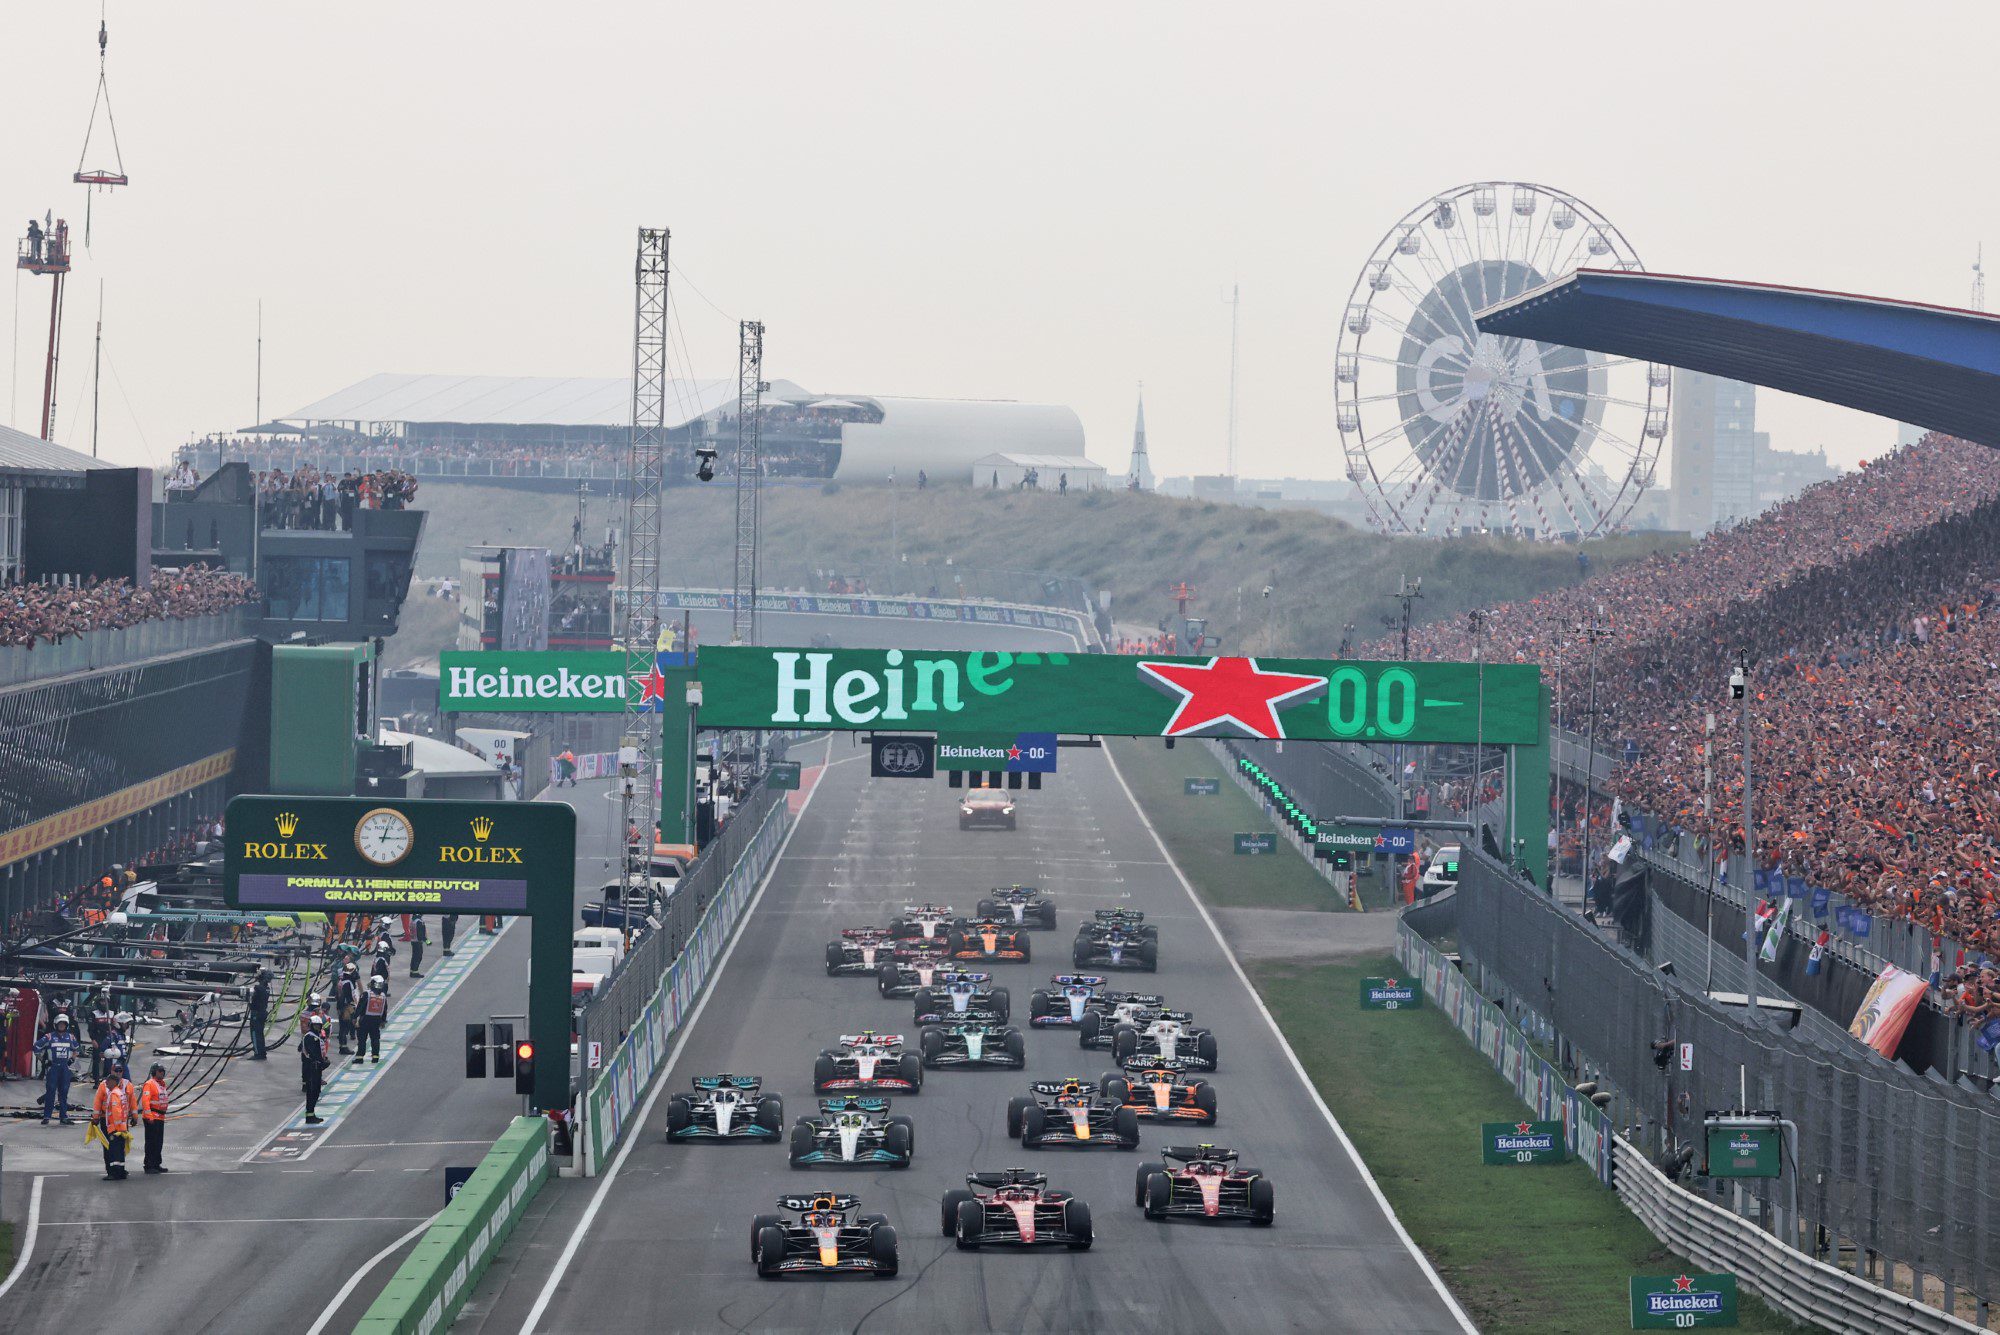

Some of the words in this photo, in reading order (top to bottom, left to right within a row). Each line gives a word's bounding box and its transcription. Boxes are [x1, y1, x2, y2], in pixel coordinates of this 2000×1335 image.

[678, 594, 718, 608] Heineken
[448, 667, 626, 699] Heineken
[1327, 665, 1417, 737] 0.0
[884, 748, 920, 767] FIA
[940, 745, 1005, 759] Heineken
[1029, 746, 1045, 759] 0.0
[1317, 832, 1372, 846] Heineken
[244, 842, 328, 860] ROLEX
[439, 846, 523, 864] ROLEX
[287, 877, 353, 889] FORMULA
[355, 878, 364, 889] 1
[365, 879, 432, 890] HEINEKEN
[435, 881, 480, 891] DUTCH
[324, 891, 372, 901] GRAND
[373, 892, 406, 901] PRIX
[407, 892, 442, 902] 2022
[1371, 989, 1412, 999] Heineken
[1497, 1138, 1550, 1149] Heineken
[1516, 1151, 1532, 1163] 0.0
[1650, 1295, 1718, 1310] Heineken
[1675, 1313, 1695, 1328] 0.0
